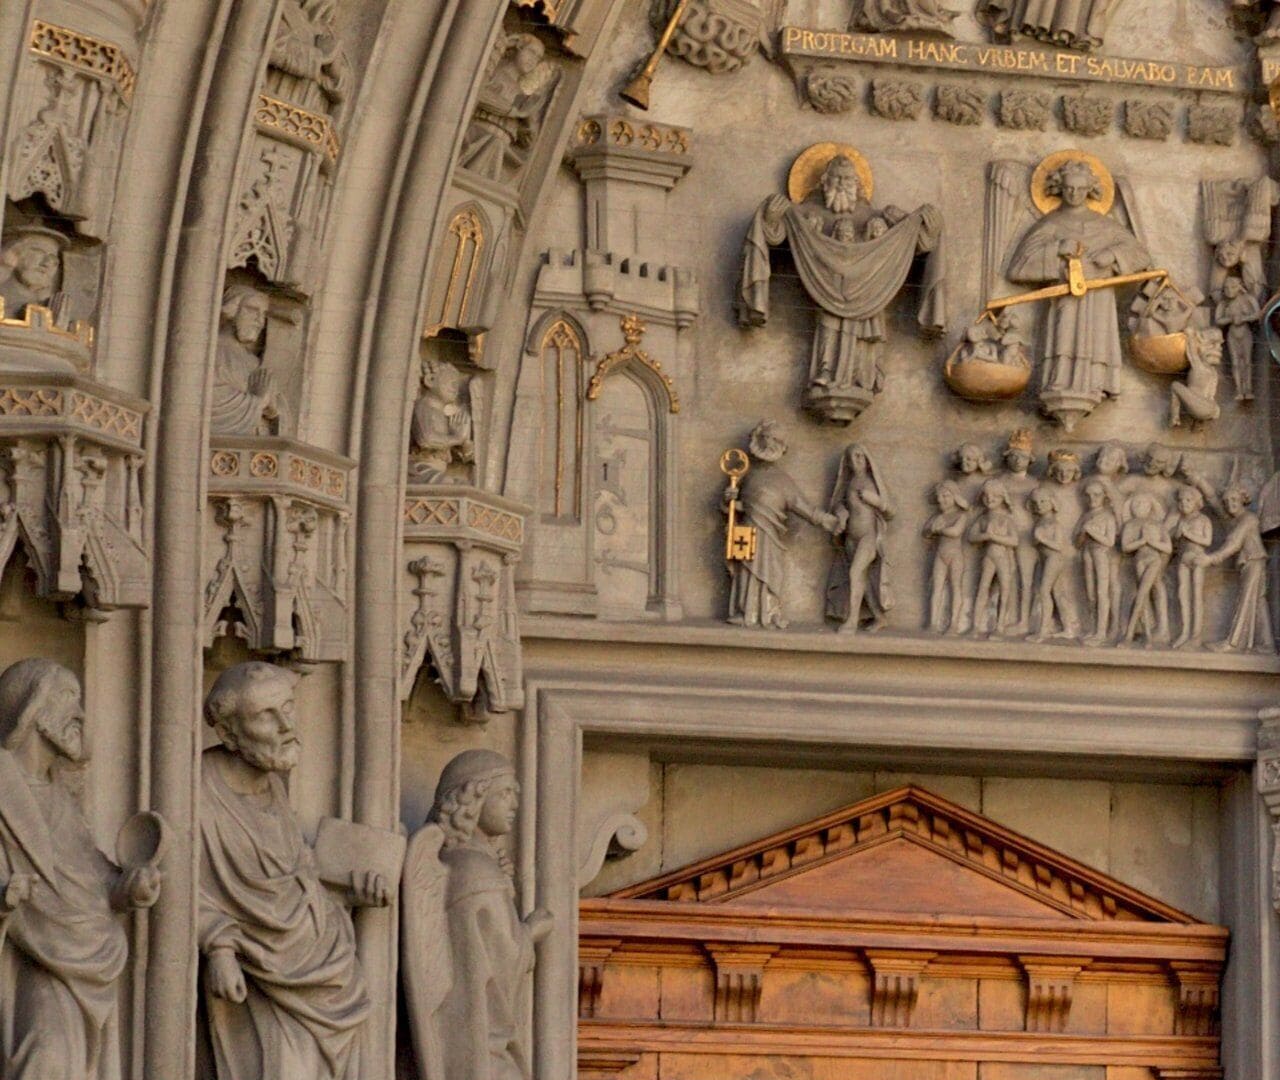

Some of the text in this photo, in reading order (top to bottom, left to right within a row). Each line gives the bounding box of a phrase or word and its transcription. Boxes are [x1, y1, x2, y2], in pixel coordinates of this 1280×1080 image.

[786, 27, 897, 58] PROTEGAM
[908, 40, 968, 64] HANC
[978, 48, 1048, 71] VRBEM
[1056, 54, 1081, 73] ET
[1087, 58, 1176, 82] SALVABO
